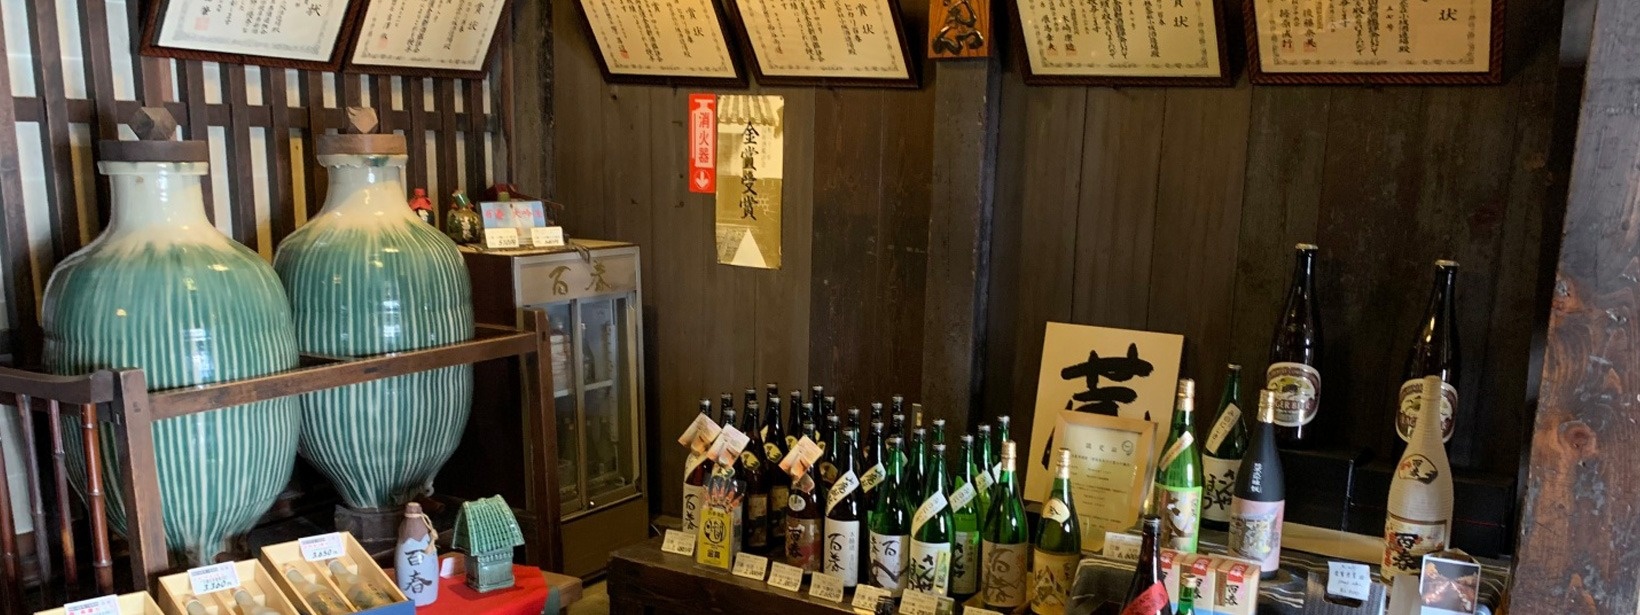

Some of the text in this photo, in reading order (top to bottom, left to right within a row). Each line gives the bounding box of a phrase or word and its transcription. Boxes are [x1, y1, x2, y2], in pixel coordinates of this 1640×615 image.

[685, 6, 704, 38] 賞状
[855, 3, 875, 35] 賞状
[1438, 8, 1458, 22] 状
[698, 111, 710, 164] 消火器
[740, 120, 759, 222] 金賞受賞
[548, 255, 613, 297] 百春
[684, 493, 699, 530] 百春
[403, 549, 433, 594] 百春
[827, 532, 846, 573] 百春
